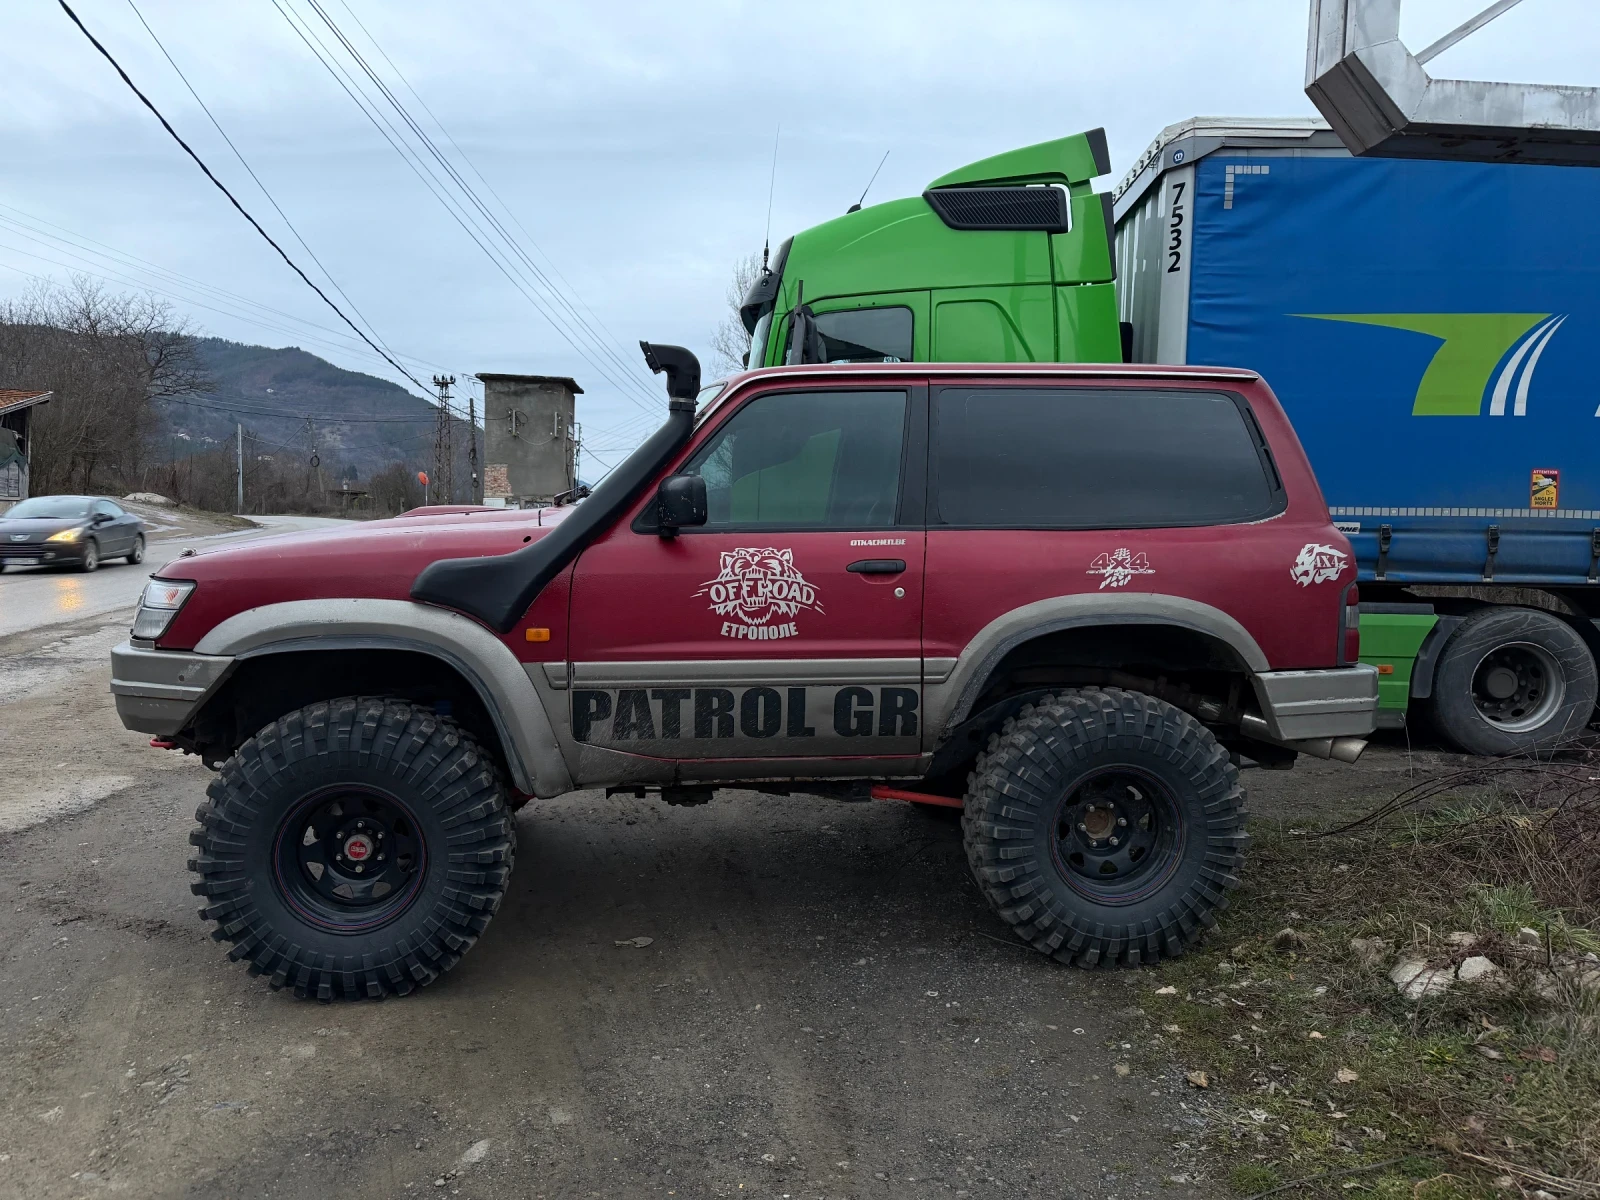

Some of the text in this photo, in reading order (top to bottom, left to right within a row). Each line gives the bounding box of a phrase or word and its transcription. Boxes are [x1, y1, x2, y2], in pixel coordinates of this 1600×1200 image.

[1167, 182, 1186, 273] 7532
[757, 580, 816, 605] ROAD
[720, 621, 799, 640] ЕТРОПОЛЕ
[571, 686, 920, 741] PATROL GR
